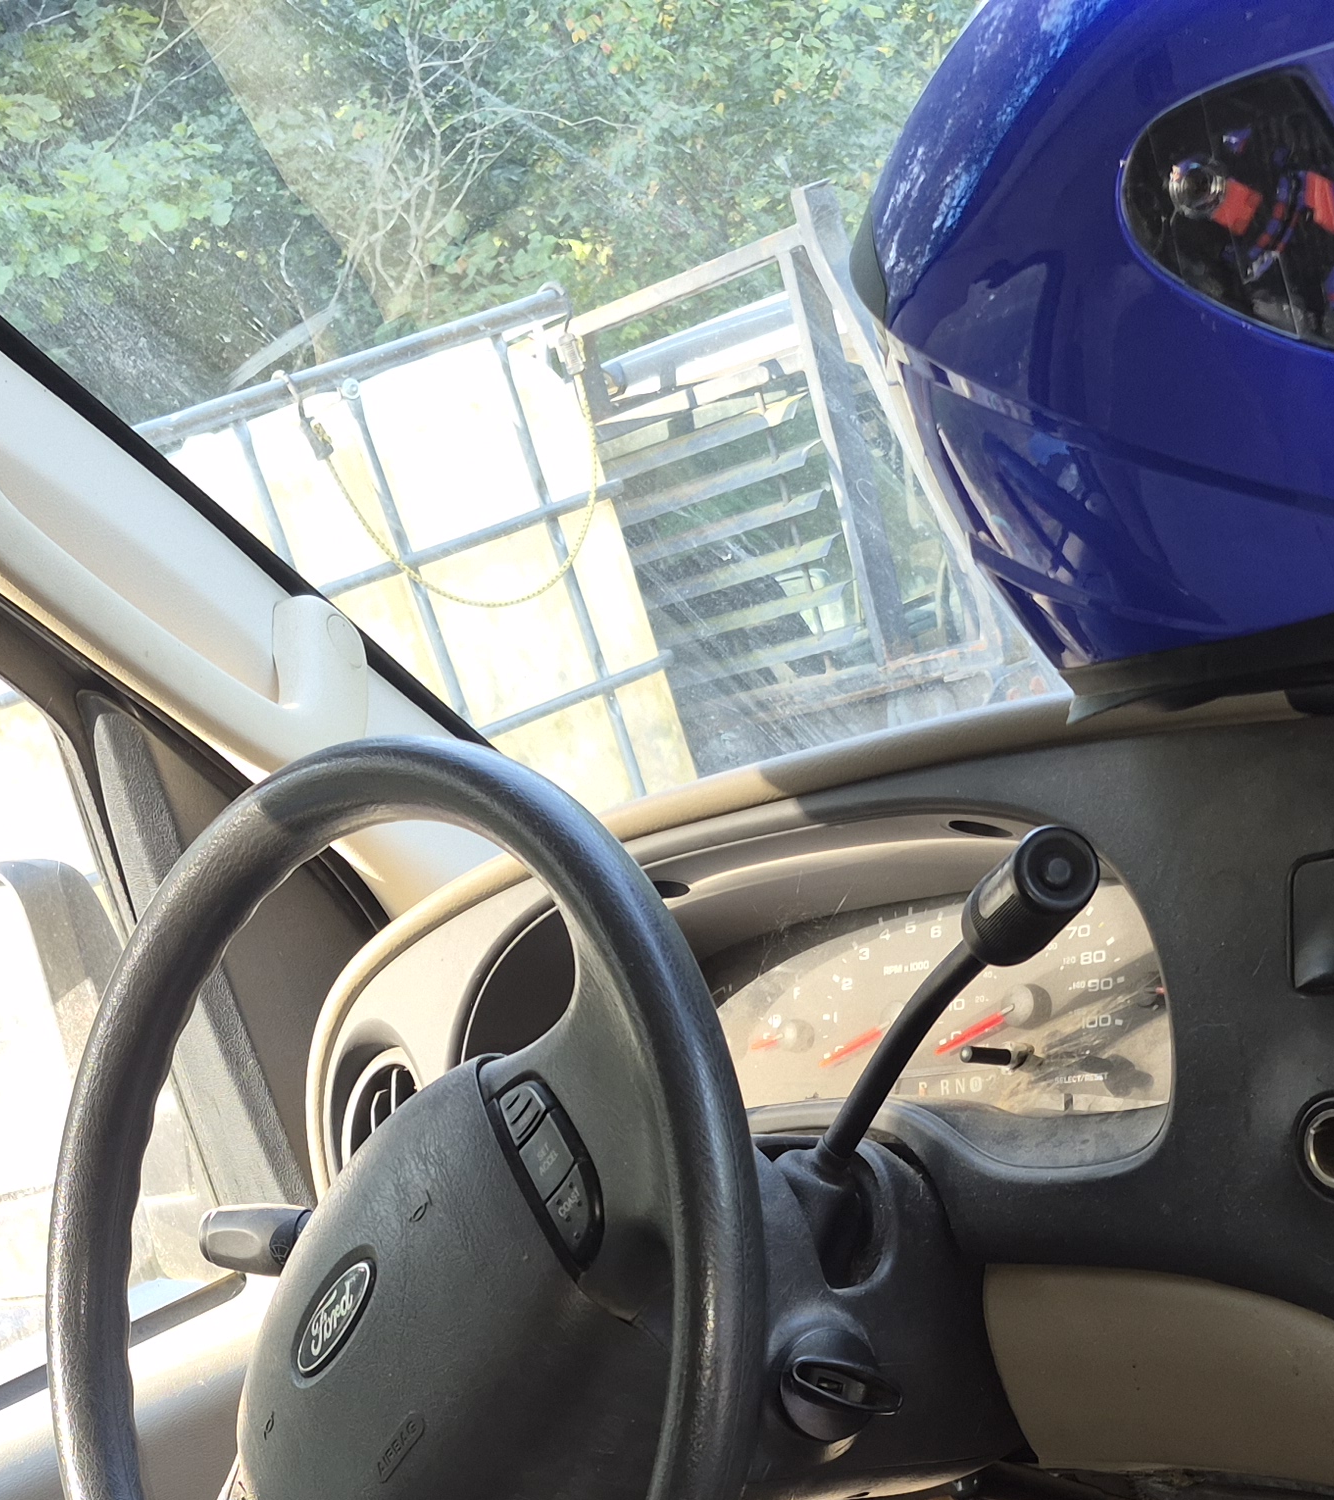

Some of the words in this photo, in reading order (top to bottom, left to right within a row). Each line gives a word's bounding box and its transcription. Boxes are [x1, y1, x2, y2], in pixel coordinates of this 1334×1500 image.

[880, 929, 890, 940] 4
[905, 922, 916, 934] 5
[930, 926, 942, 938] 6
[1066, 924, 1091, 939] 70
[859, 948, 870, 960] 3
[1080, 950, 1106, 965] 80
[884, 964, 903, 976] RPM
[910, 960, 930, 973] 1000
[841, 977, 853, 991] 2
[1087, 977, 1113, 992] 90
[1081, 1015, 1111, 1029] 100
[940, 1079, 950, 1095] R
[955, 1077, 965, 1093] N
[558, 1187, 581, 1218] COAST
[311, 1276, 360, 1356] Ford
[377, 1419, 417, 1477] AIRBAG
